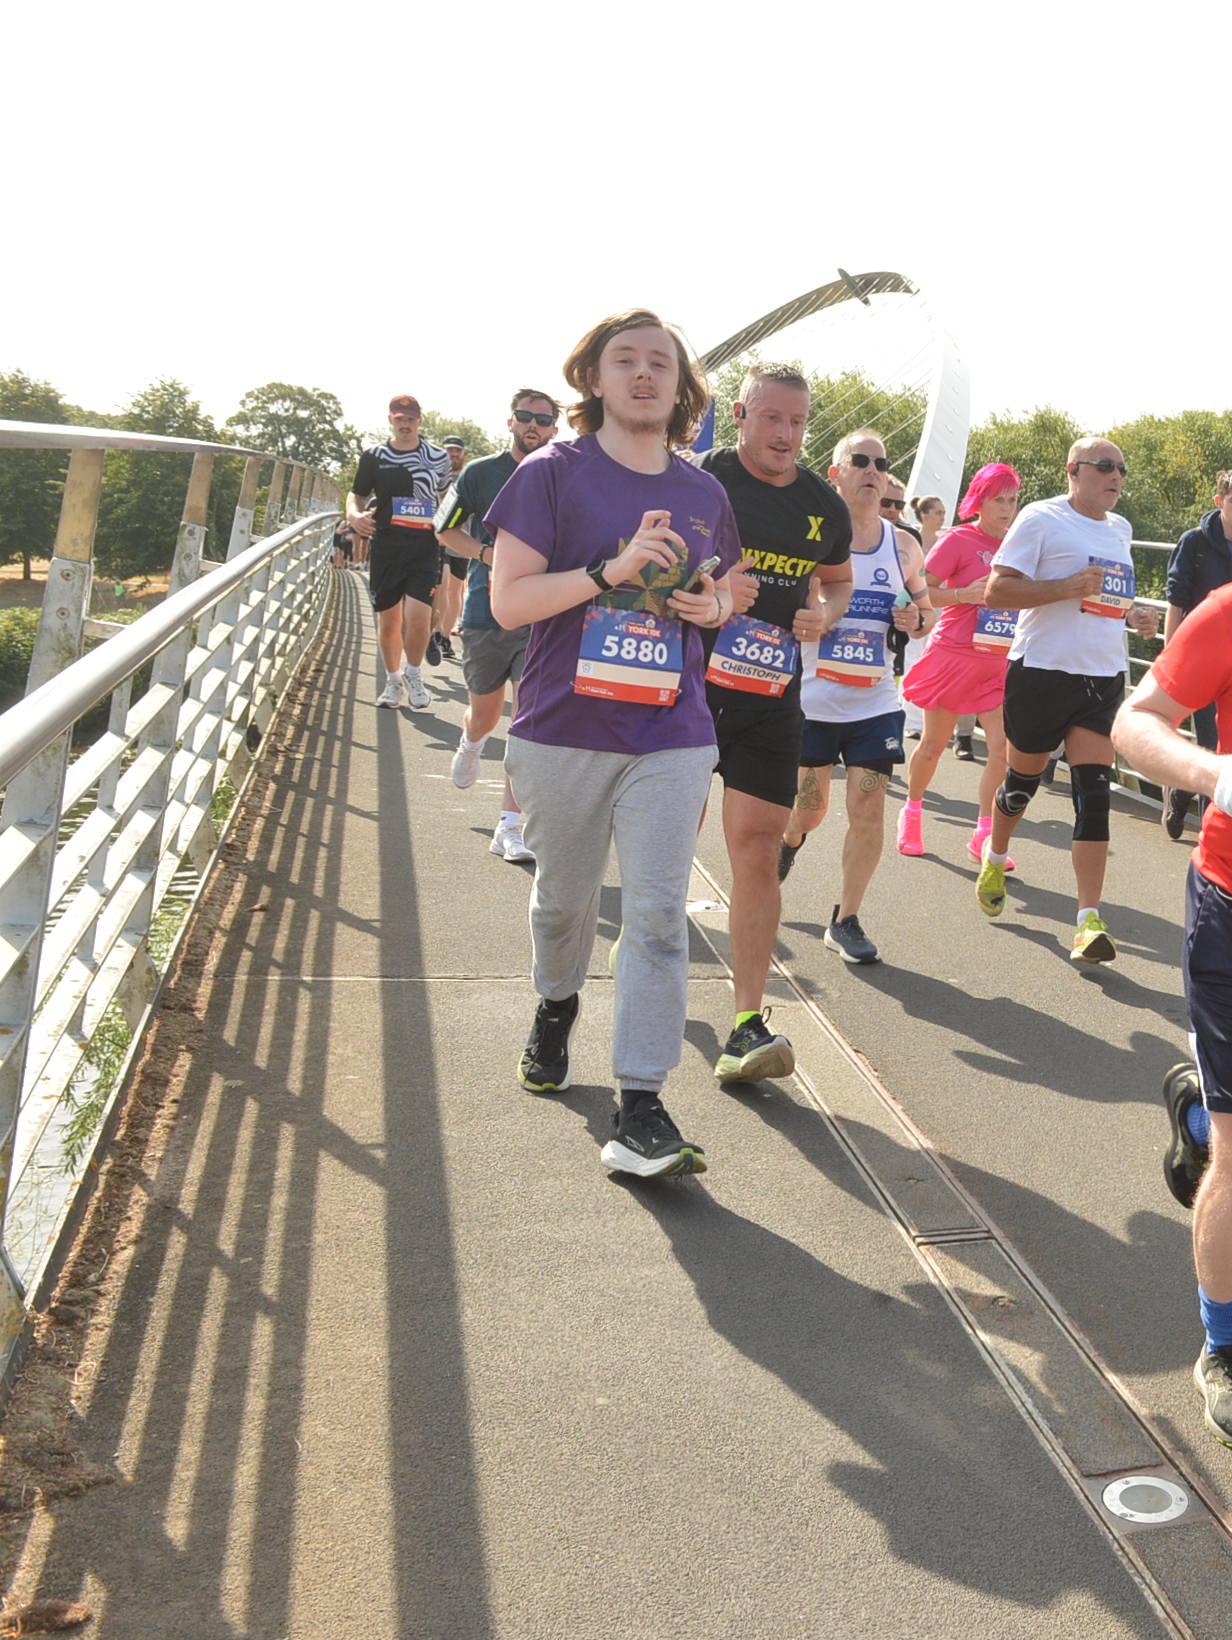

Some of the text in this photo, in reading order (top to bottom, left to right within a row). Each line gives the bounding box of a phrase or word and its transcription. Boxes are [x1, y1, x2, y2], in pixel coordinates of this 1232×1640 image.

[399, 505, 426, 516] 5401
[806, 515, 825, 542] X
[1103, 575, 1128, 594] 301
[984, 620, 1016, 635] 6579
[601, 634, 668, 665] 5880
[731, 636, 786, 668] 3682
[831, 645, 875, 662] 5845
[720, 660, 782, 681] CHRISTOPH
